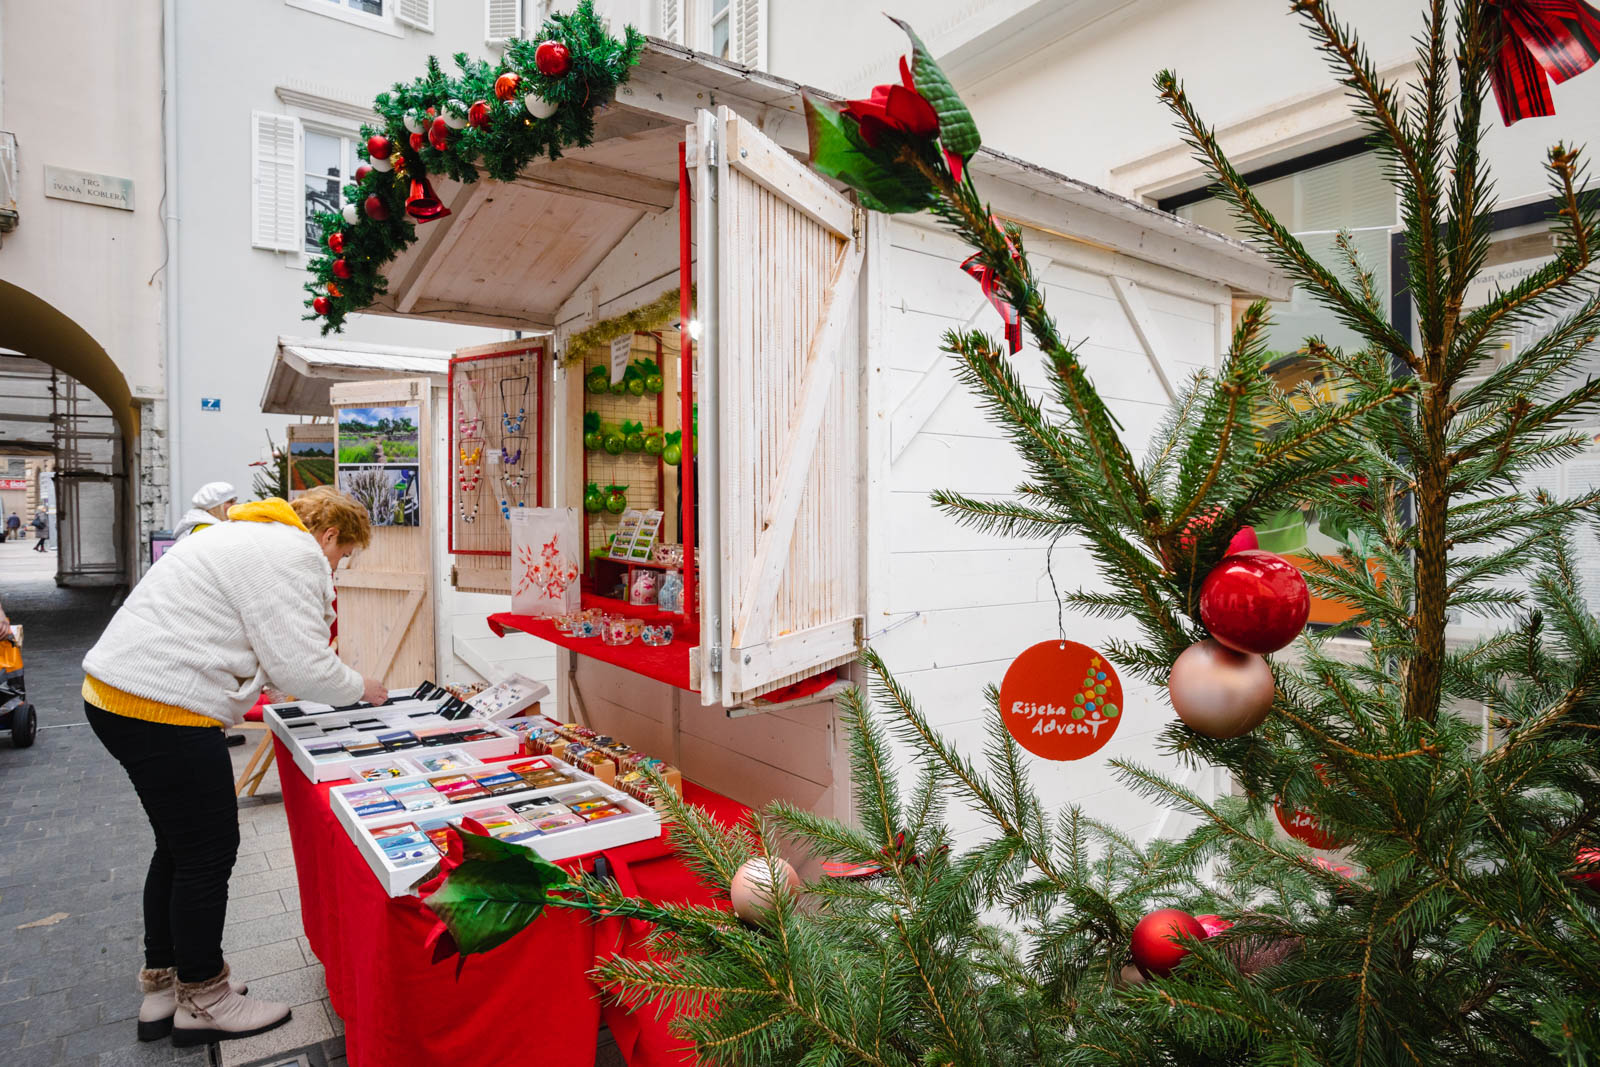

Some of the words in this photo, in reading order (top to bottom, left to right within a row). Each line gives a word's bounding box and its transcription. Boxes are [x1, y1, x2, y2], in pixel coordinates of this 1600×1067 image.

[81, 178, 100, 187] TRG
[53, 183, 82, 194] IVANA
[87, 188, 126, 201] KOBLERA
[1472, 273, 1495, 286] Ivan
[1498, 267, 1535, 281] Kobler
[1011, 701, 1066, 719] Rijeka
